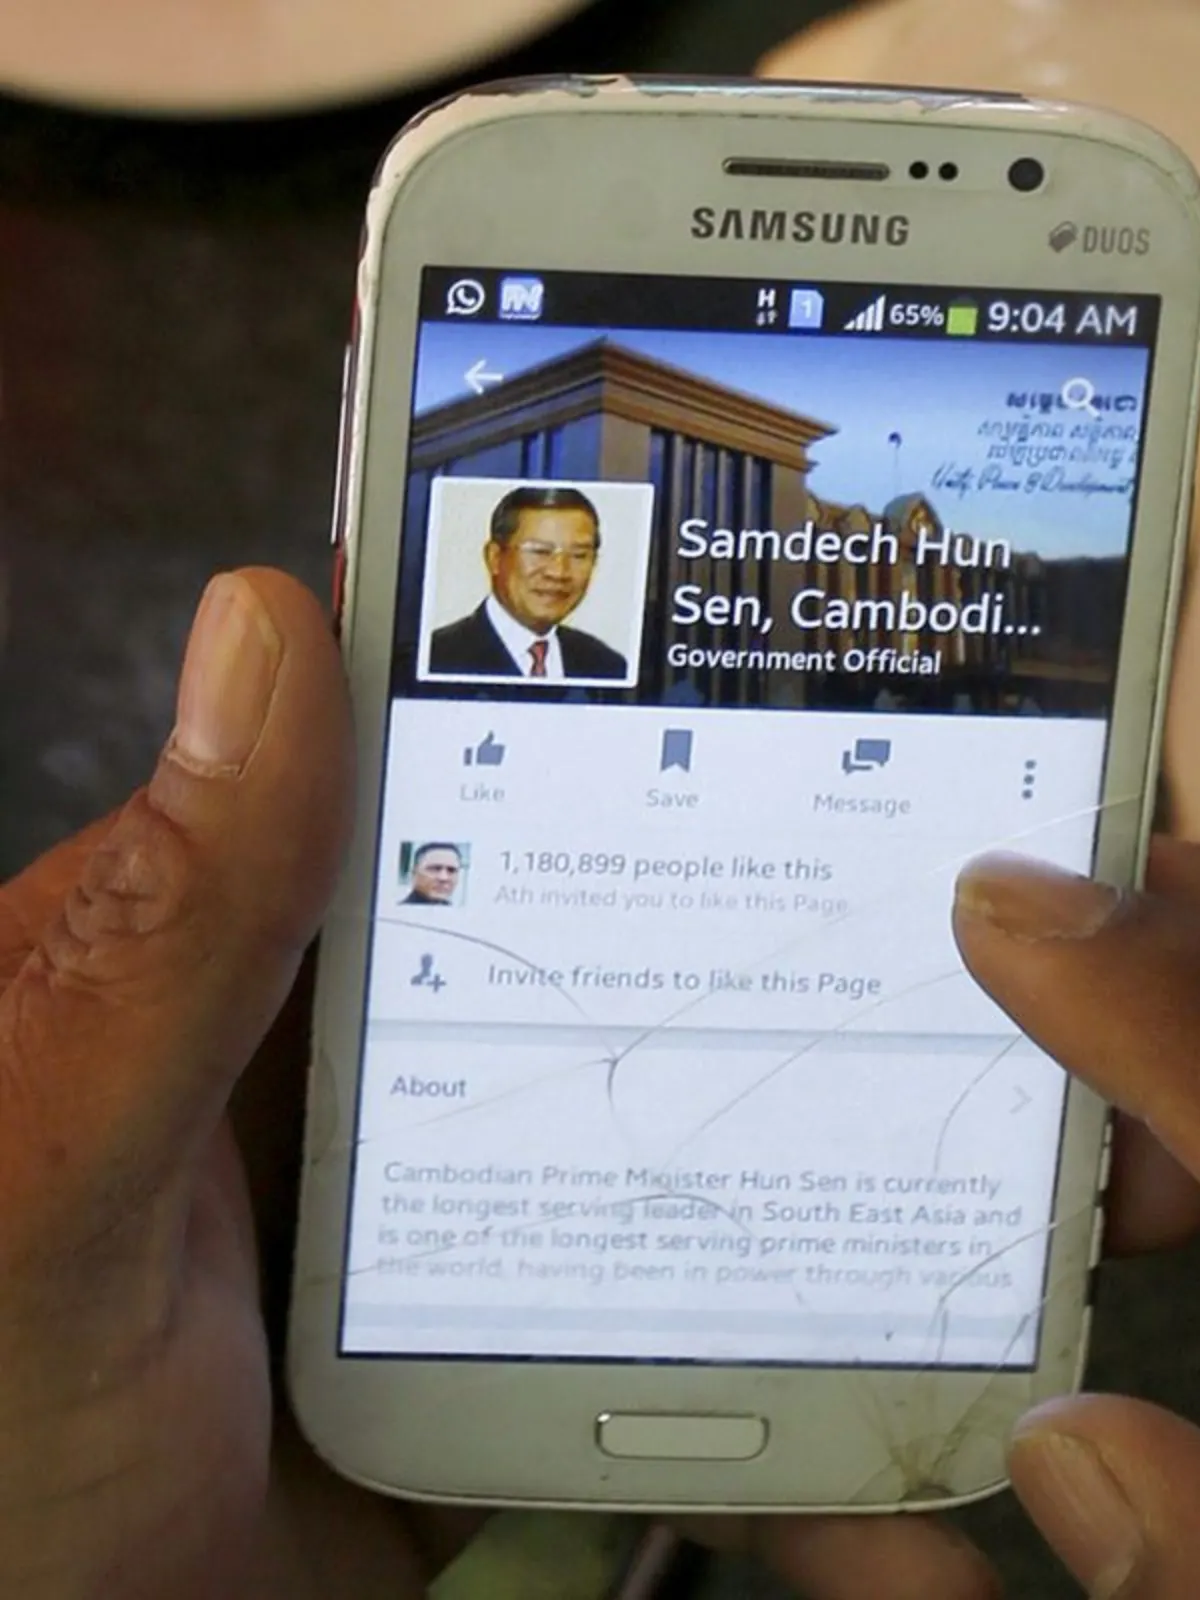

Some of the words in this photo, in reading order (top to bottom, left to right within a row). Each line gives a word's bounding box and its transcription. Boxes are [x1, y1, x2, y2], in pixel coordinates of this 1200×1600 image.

[691, 207, 910, 246] SAMSUNG
[1082, 224, 1151, 255] DUOS
[757, 288, 776, 308] H
[889, 303, 945, 326] 65%
[987, 302, 1067, 333] 9:04
[1076, 305, 1138, 336] AM
[677, 518, 898, 566] Samdech
[915, 527, 1013, 569] Hun
[671, 585, 775, 634] Sen,
[791, 589, 1043, 637] Cambodi...
[667, 645, 836, 675] Government
[843, 647, 942, 677] Official
[460, 783, 506, 804] Like
[646, 787, 700, 809] Save
[813, 792, 911, 817] Message
[499, 851, 626, 878] 1,180,899
[634, 855, 724, 883] people
[731, 856, 776, 880] like
[784, 858, 834, 881] this
[494, 885, 534, 904] Ath
[540, 886, 617, 908] invited
[624, 891, 663, 911] you
[671, 890, 694, 909] to
[700, 889, 738, 910] like
[745, 891, 786, 912] this
[794, 894, 849, 917] Page
[488, 965, 565, 987] Invite
[572, 965, 664, 990] friends
[673, 970, 700, 990] to
[709, 970, 753, 993] like
[761, 970, 809, 993] this
[818, 972, 882, 999] Page
[390, 1076, 467, 1098] About
[383, 1161, 533, 1186] Cambodian
[541, 1165, 618, 1187] Prime
[625, 1167, 732, 1191] Minister
[740, 1170, 791, 1191] Hun
[799, 1170, 848, 1192] Sen
[856, 1172, 877, 1193] is
[883, 1174, 1002, 1200] currently
[382, 1195, 426, 1214] the
[432, 1196, 530, 1221] longest
[539, 1199, 636, 1224] serving
[643, 1200, 721, 1220] leader
[731, 1203, 753, 1221] in
[762, 1201, 841, 1223] South
[849, 1203, 904, 1225] East
[911, 1205, 966, 1226] Asia
[973, 1206, 1023, 1227] and
[377, 1226, 399, 1245] is
[406, 1230, 458, 1247] one
[463, 1225, 493, 1247] of
[501, 1228, 544, 1248] the
[551, 1230, 648, 1253] longest
[656, 1231, 751, 1257] serving
[760, 1233, 836, 1258] prime
[842, 1235, 962, 1256] ministers
[969, 1237, 992, 1256] in
[517, 1259, 605, 1286] having
[613, 1261, 675, 1282] been
[684, 1263, 707, 1283] in
[715, 1265, 797, 1286] power
[805, 1264, 911, 1290] through
